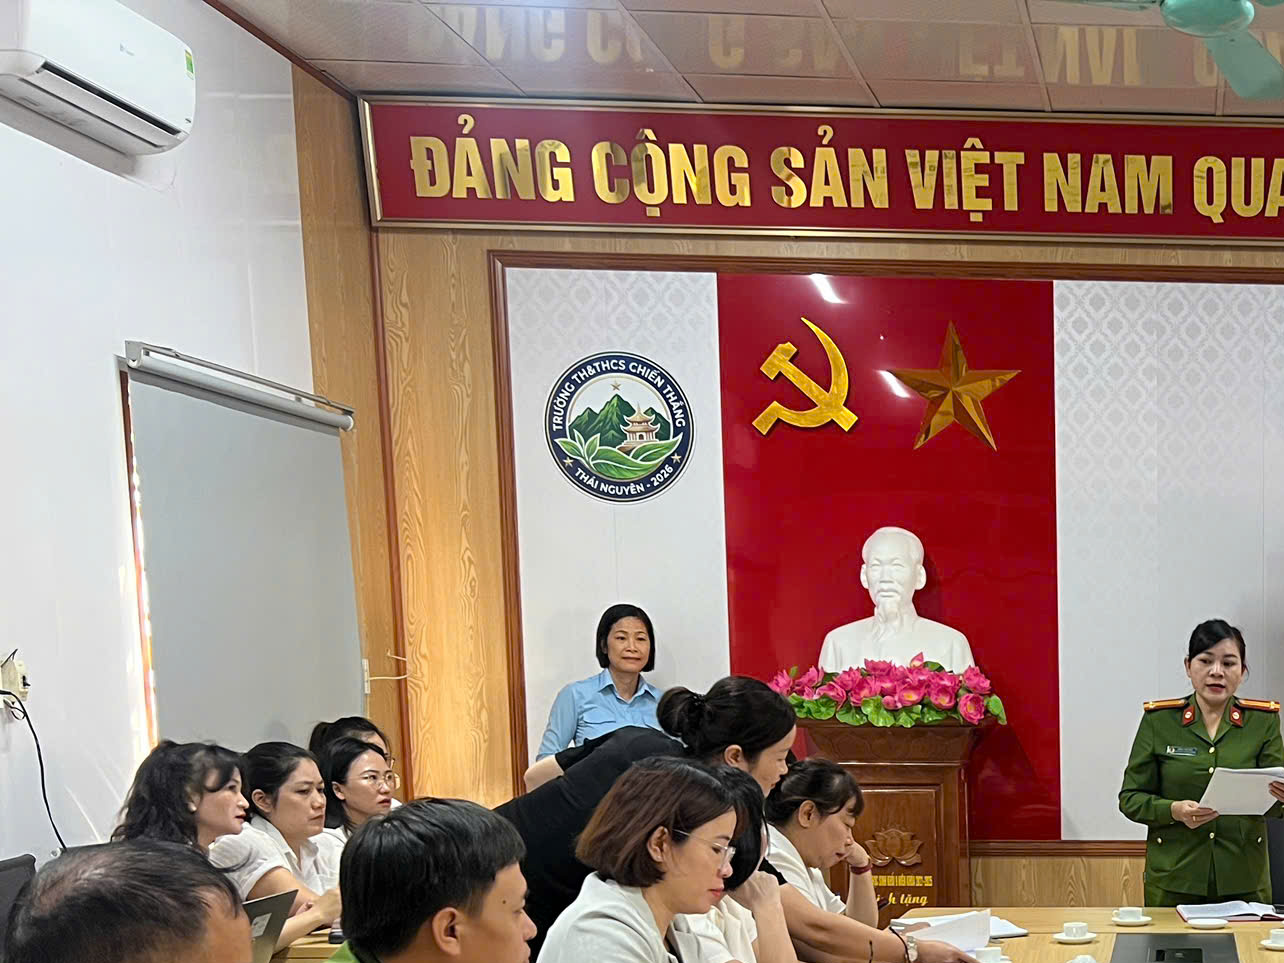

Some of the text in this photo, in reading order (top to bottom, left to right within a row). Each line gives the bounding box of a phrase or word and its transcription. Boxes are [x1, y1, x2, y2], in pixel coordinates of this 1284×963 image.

[410, 114, 573, 203] ĐẢNG
[592, 129, 751, 217] CỘNG
[771, 125, 887, 209] SẢN
[906, 138, 1025, 222] VIỆT
[1044, 153, 1173, 215] NAM
[552, 359, 686, 432] TRƯỜNG TH&THCS CHIẾN THẮNG
[575, 467, 599, 489] THÁI
[600, 483, 645, 496] NGUYÊN
[650, 464, 674, 487] 2026
